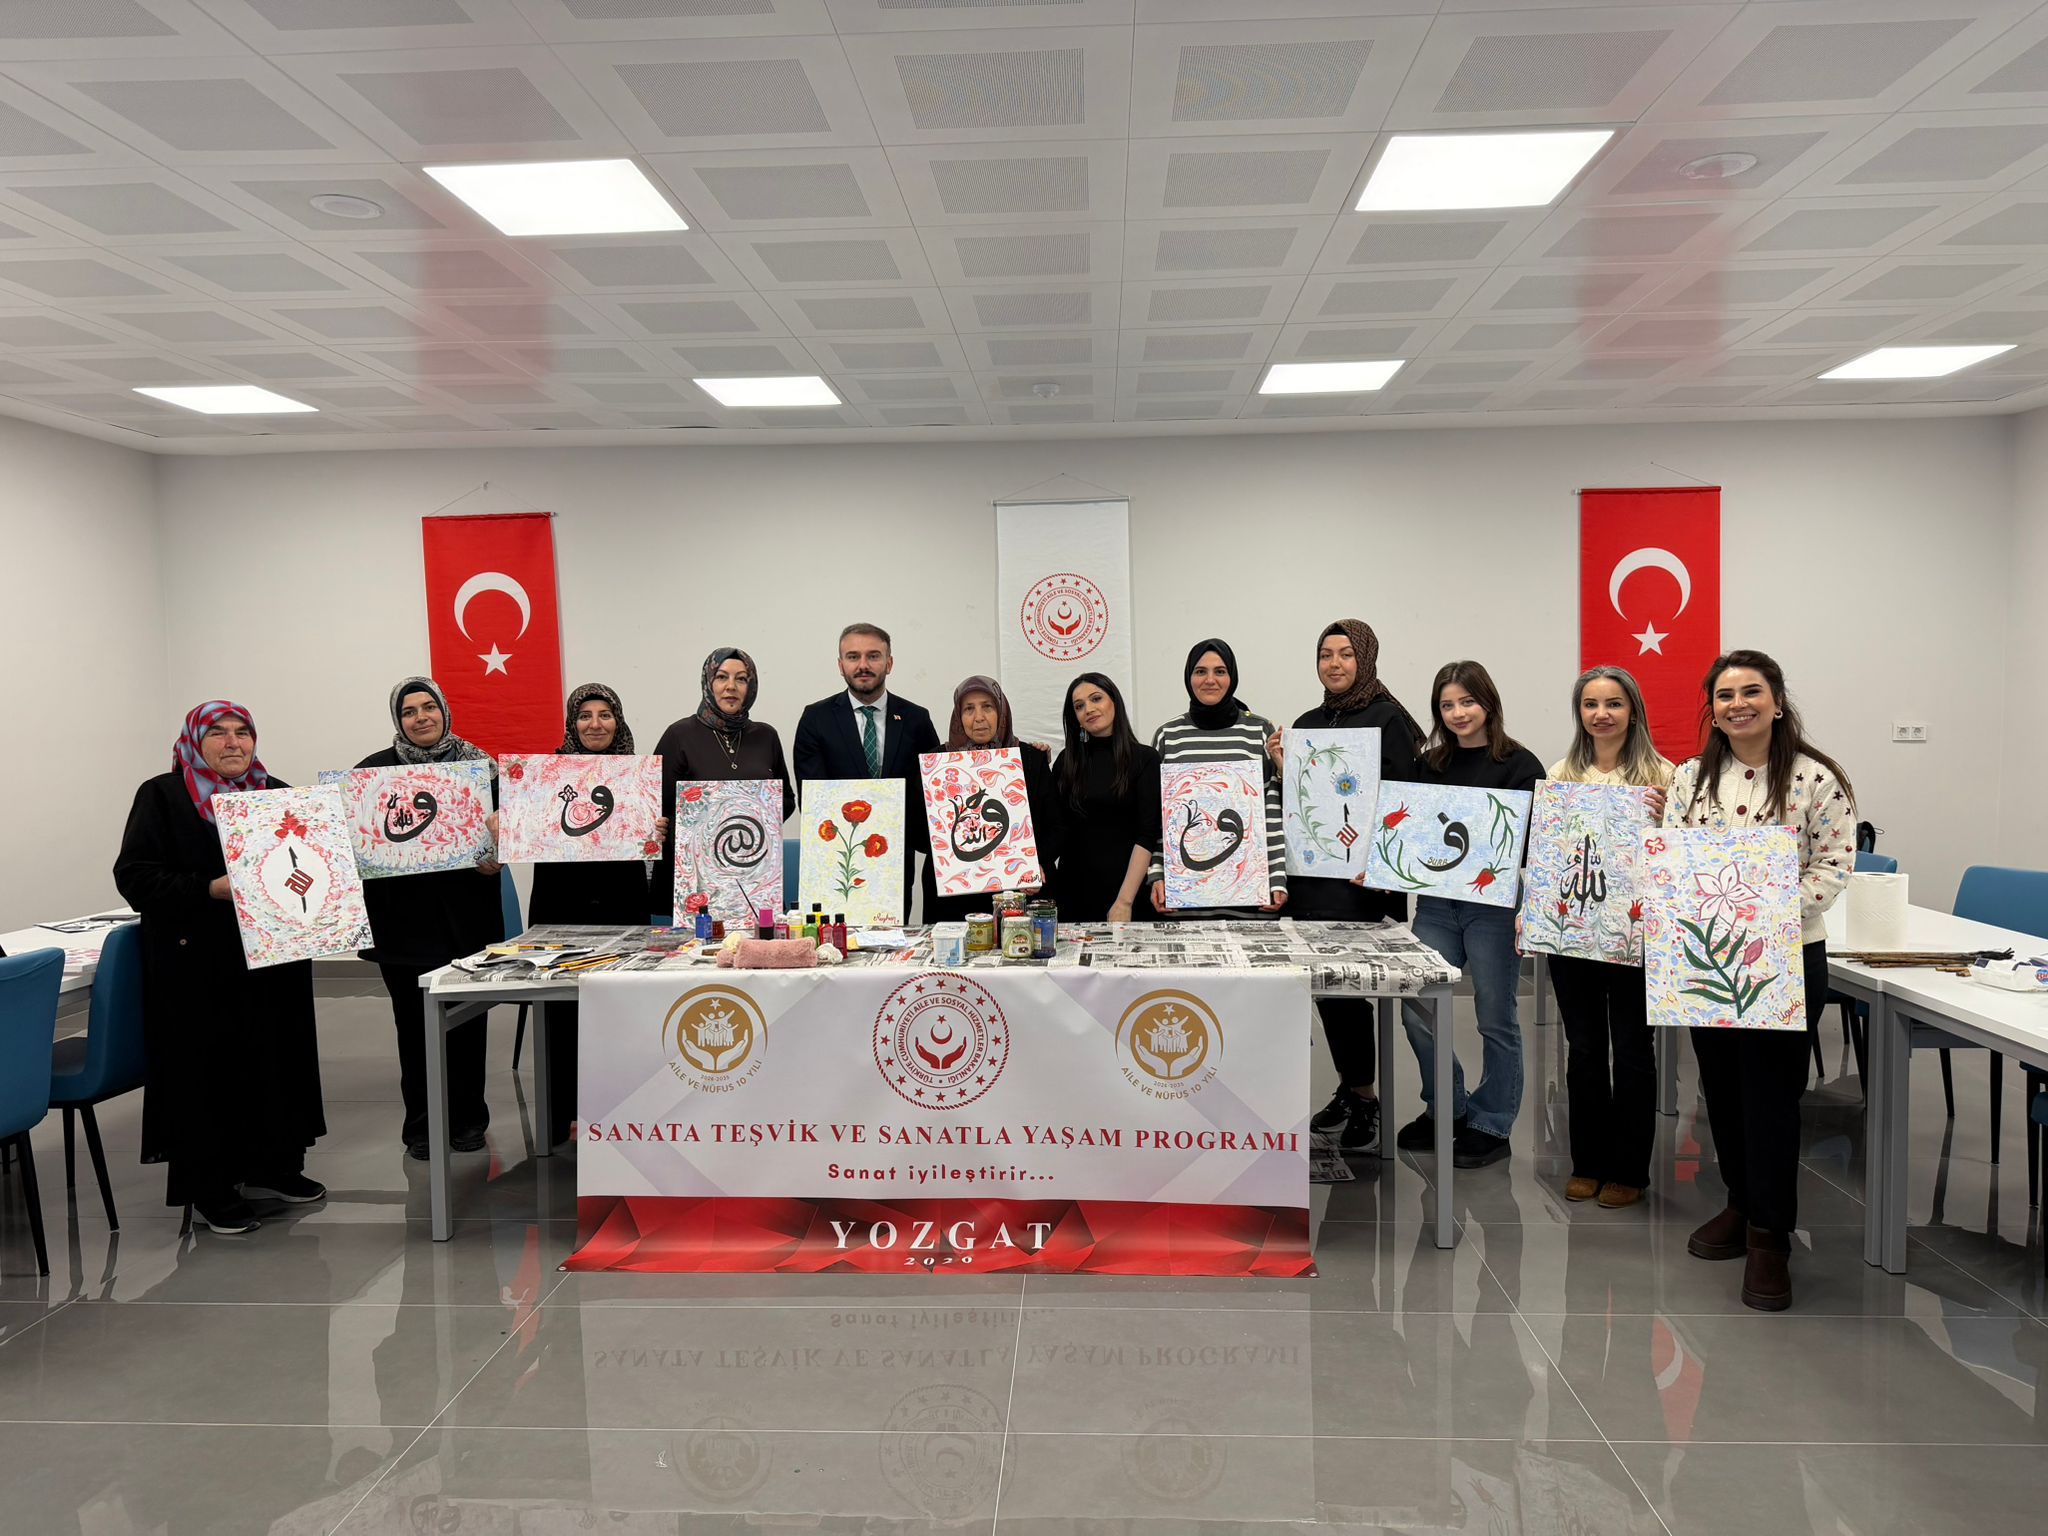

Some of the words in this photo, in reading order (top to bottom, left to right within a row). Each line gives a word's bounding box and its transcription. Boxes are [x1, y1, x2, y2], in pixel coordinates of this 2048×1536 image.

[913, 1000, 929, 1011] AİLE
[941, 997, 968, 1012] SOSYAL
[898, 1010, 914, 1060] CUMHURİYETİ
[968, 1010, 984, 1053] HİZMETLER
[668, 1061, 687, 1081] AİLE
[687, 1078, 700, 1090] VE
[702, 1083, 735, 1093] NÜFUS
[736, 1077, 747, 1087] 10
[906, 1061, 933, 1083] TÜRKİYE
[948, 1053, 983, 1084] BAKANLIĞI
[1121, 1066, 1140, 1087] AİLE
[1140, 1084, 1153, 1096] VE
[1154, 1089, 1189, 1100] NÜFUS
[1190, 1083, 1202, 1094] 10
[588, 1122, 701, 1143] SANATA
[710, 1118, 820, 1147] TEŞVİK
[830, 1123, 867, 1143] VE
[878, 1125, 1013, 1145] SANATLA
[1022, 1125, 1122, 1149] YAŞAM
[1134, 1129, 1299, 1152] PROGRAMI
[828, 1163, 897, 1180] Sanat
[908, 1164, 1054, 1184] iyileştirir...
[830, 1220, 1051, 1250] YOZGAT
